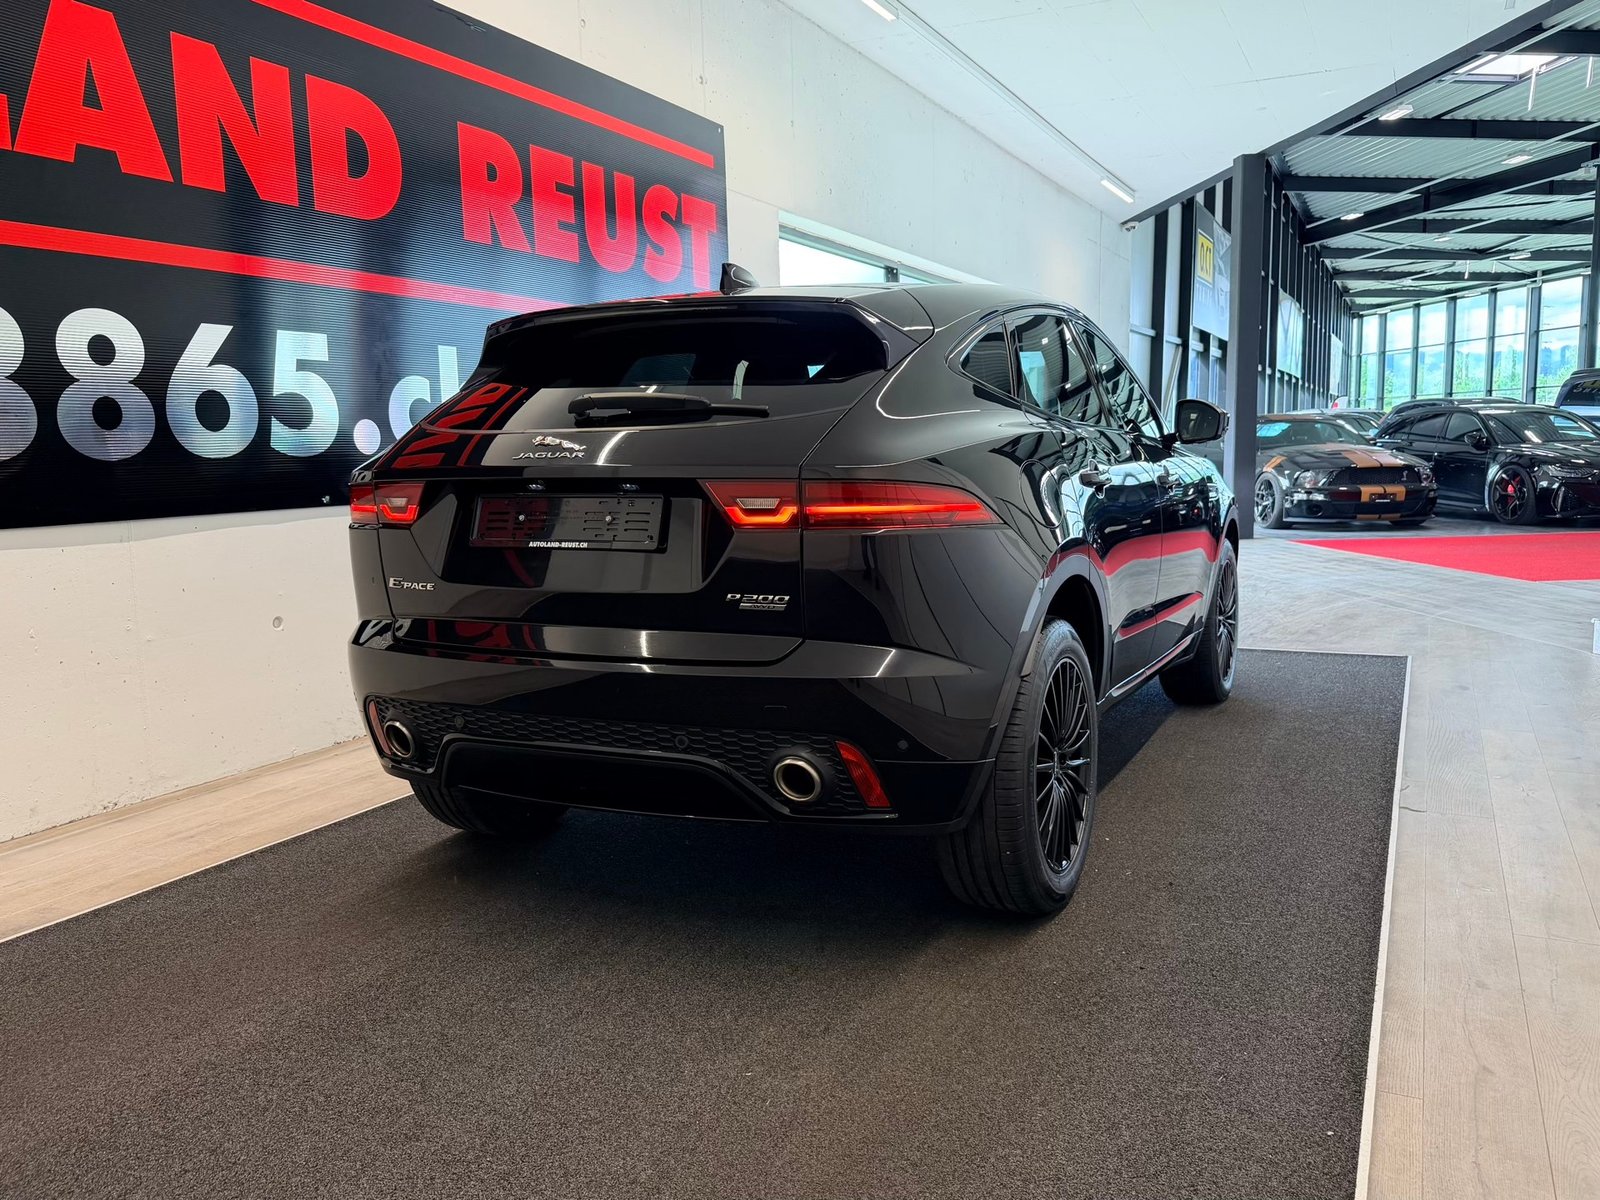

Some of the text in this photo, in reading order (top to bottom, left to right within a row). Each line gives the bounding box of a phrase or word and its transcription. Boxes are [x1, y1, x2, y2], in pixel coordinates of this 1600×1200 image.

[0, 0, 718, 292] AND REUST
[512, 451, 586, 460] JAGUAR
[528, 541, 589, 549] AUTOLAND-REUST.CH
